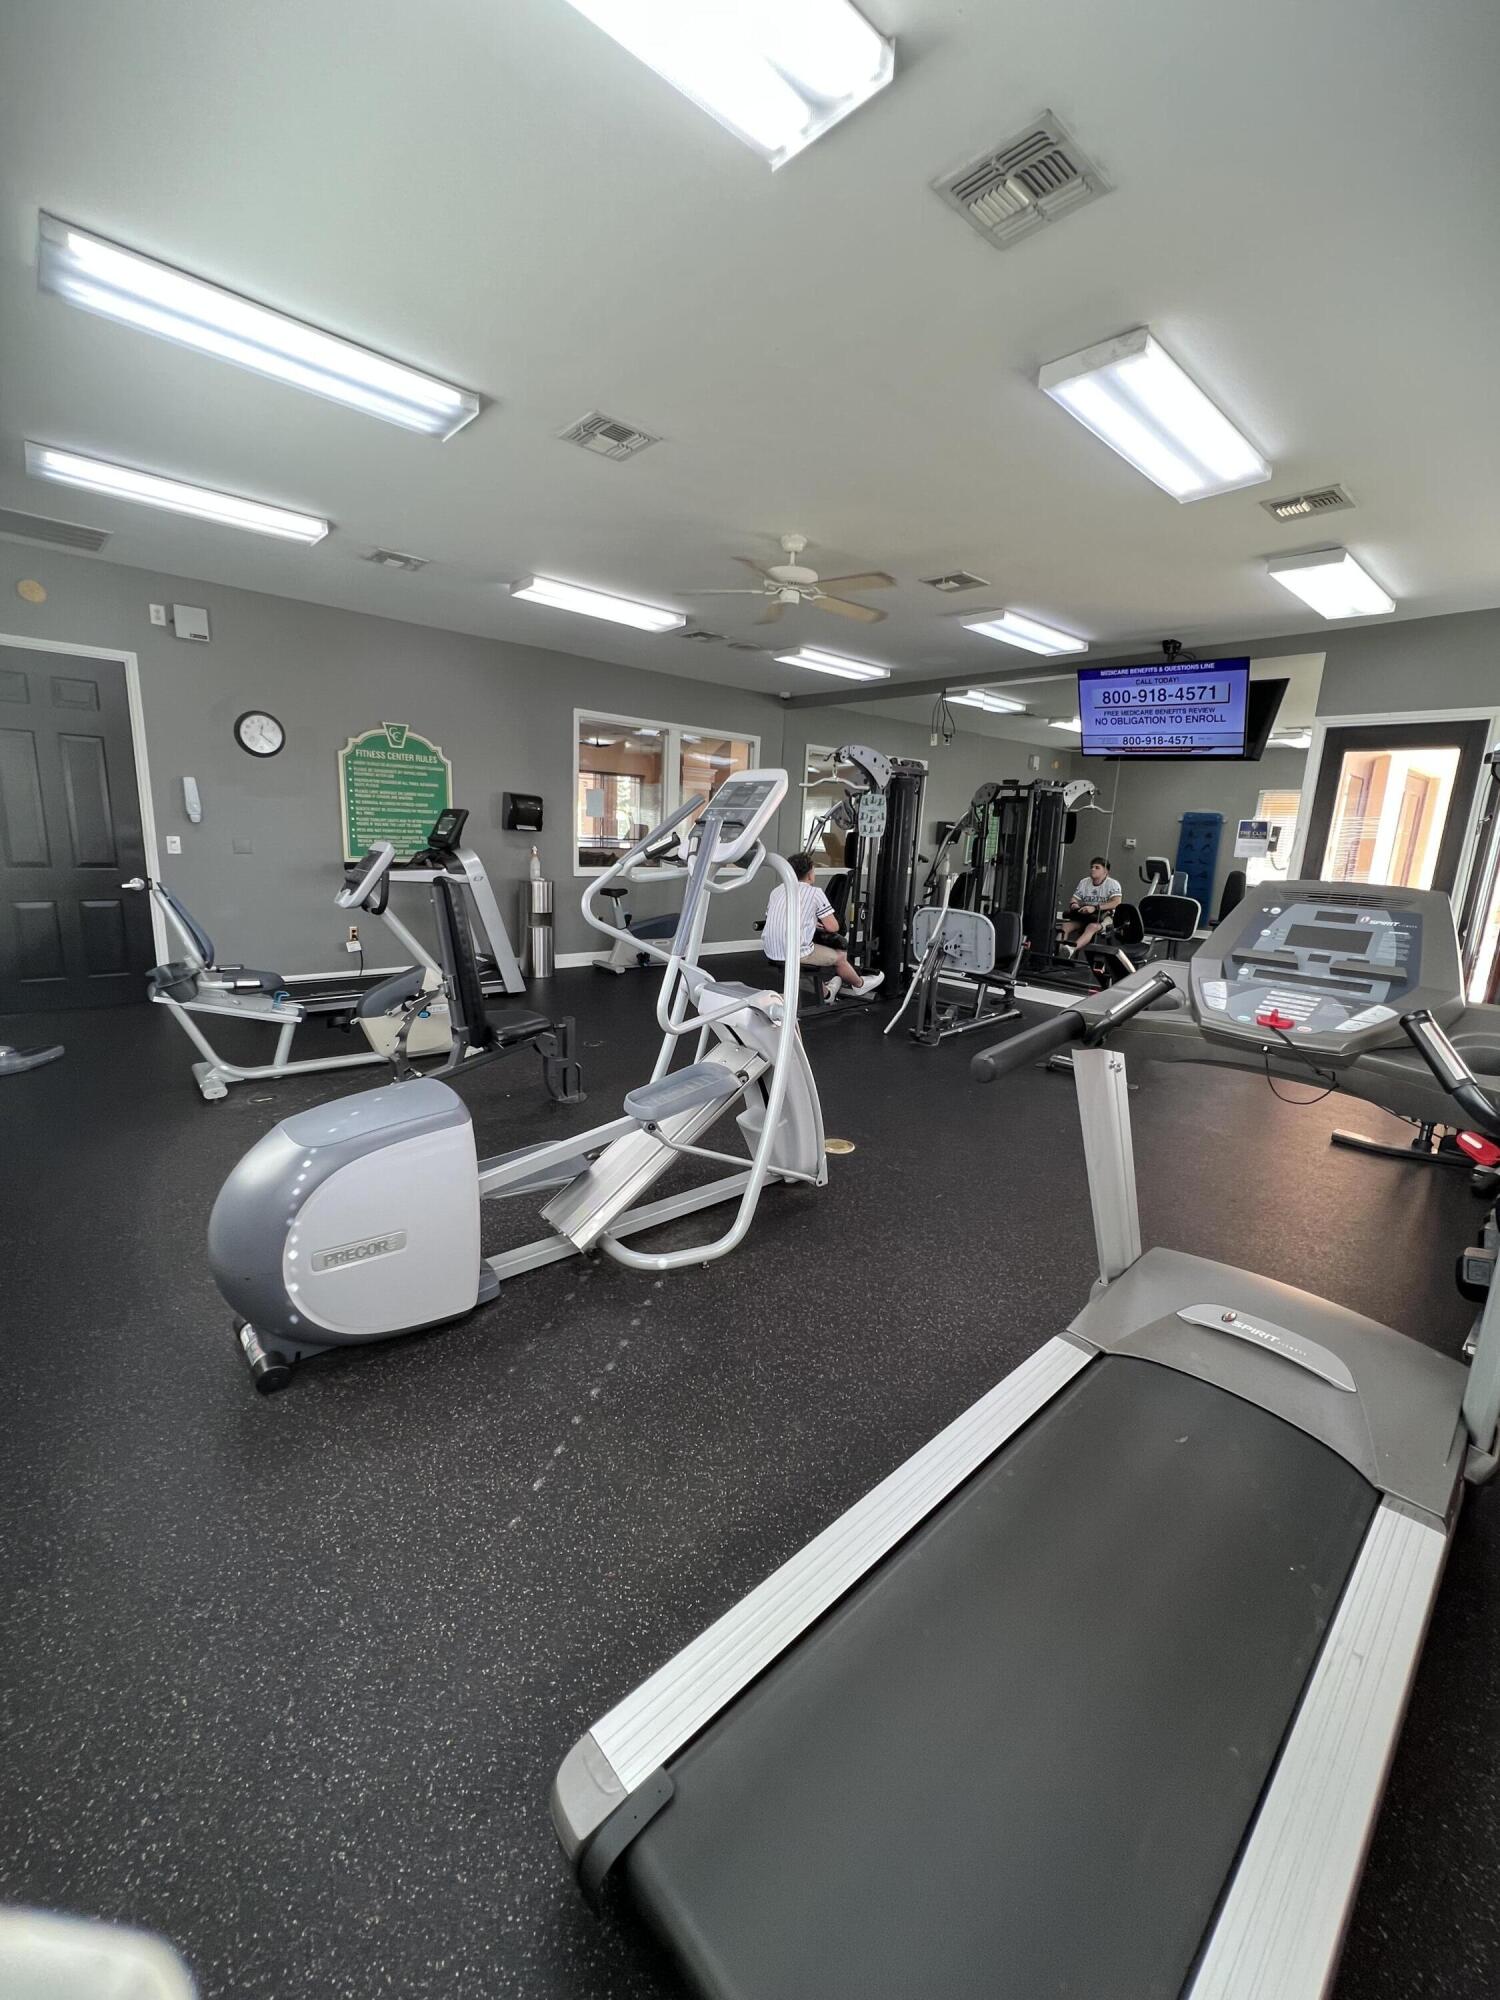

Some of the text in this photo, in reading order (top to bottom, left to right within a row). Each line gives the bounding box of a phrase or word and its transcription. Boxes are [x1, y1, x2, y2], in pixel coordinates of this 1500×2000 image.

[1100, 667, 1129, 676] MEDICARE
[1130, 666, 1158, 674] BENEFITS
[1164, 664, 1199, 672] QUESTIONS
[1200, 662, 1215, 670] LINE
[1102, 685, 1216, 704] 800-918-4571
[1153, 707, 1187, 715] BENEFITS
[1188, 706, 1216, 714] REVIEW
[1095, 714, 1227, 726] NO OBLIGATION TO ENROLL
[1122, 735, 1194, 746] 800-918-4571
[355, 749, 438, 764] FITNESS CENTER RULES
[324, 1240, 389, 1267] PRECOR
[1231, 1320, 1281, 1343] SPIRIT
